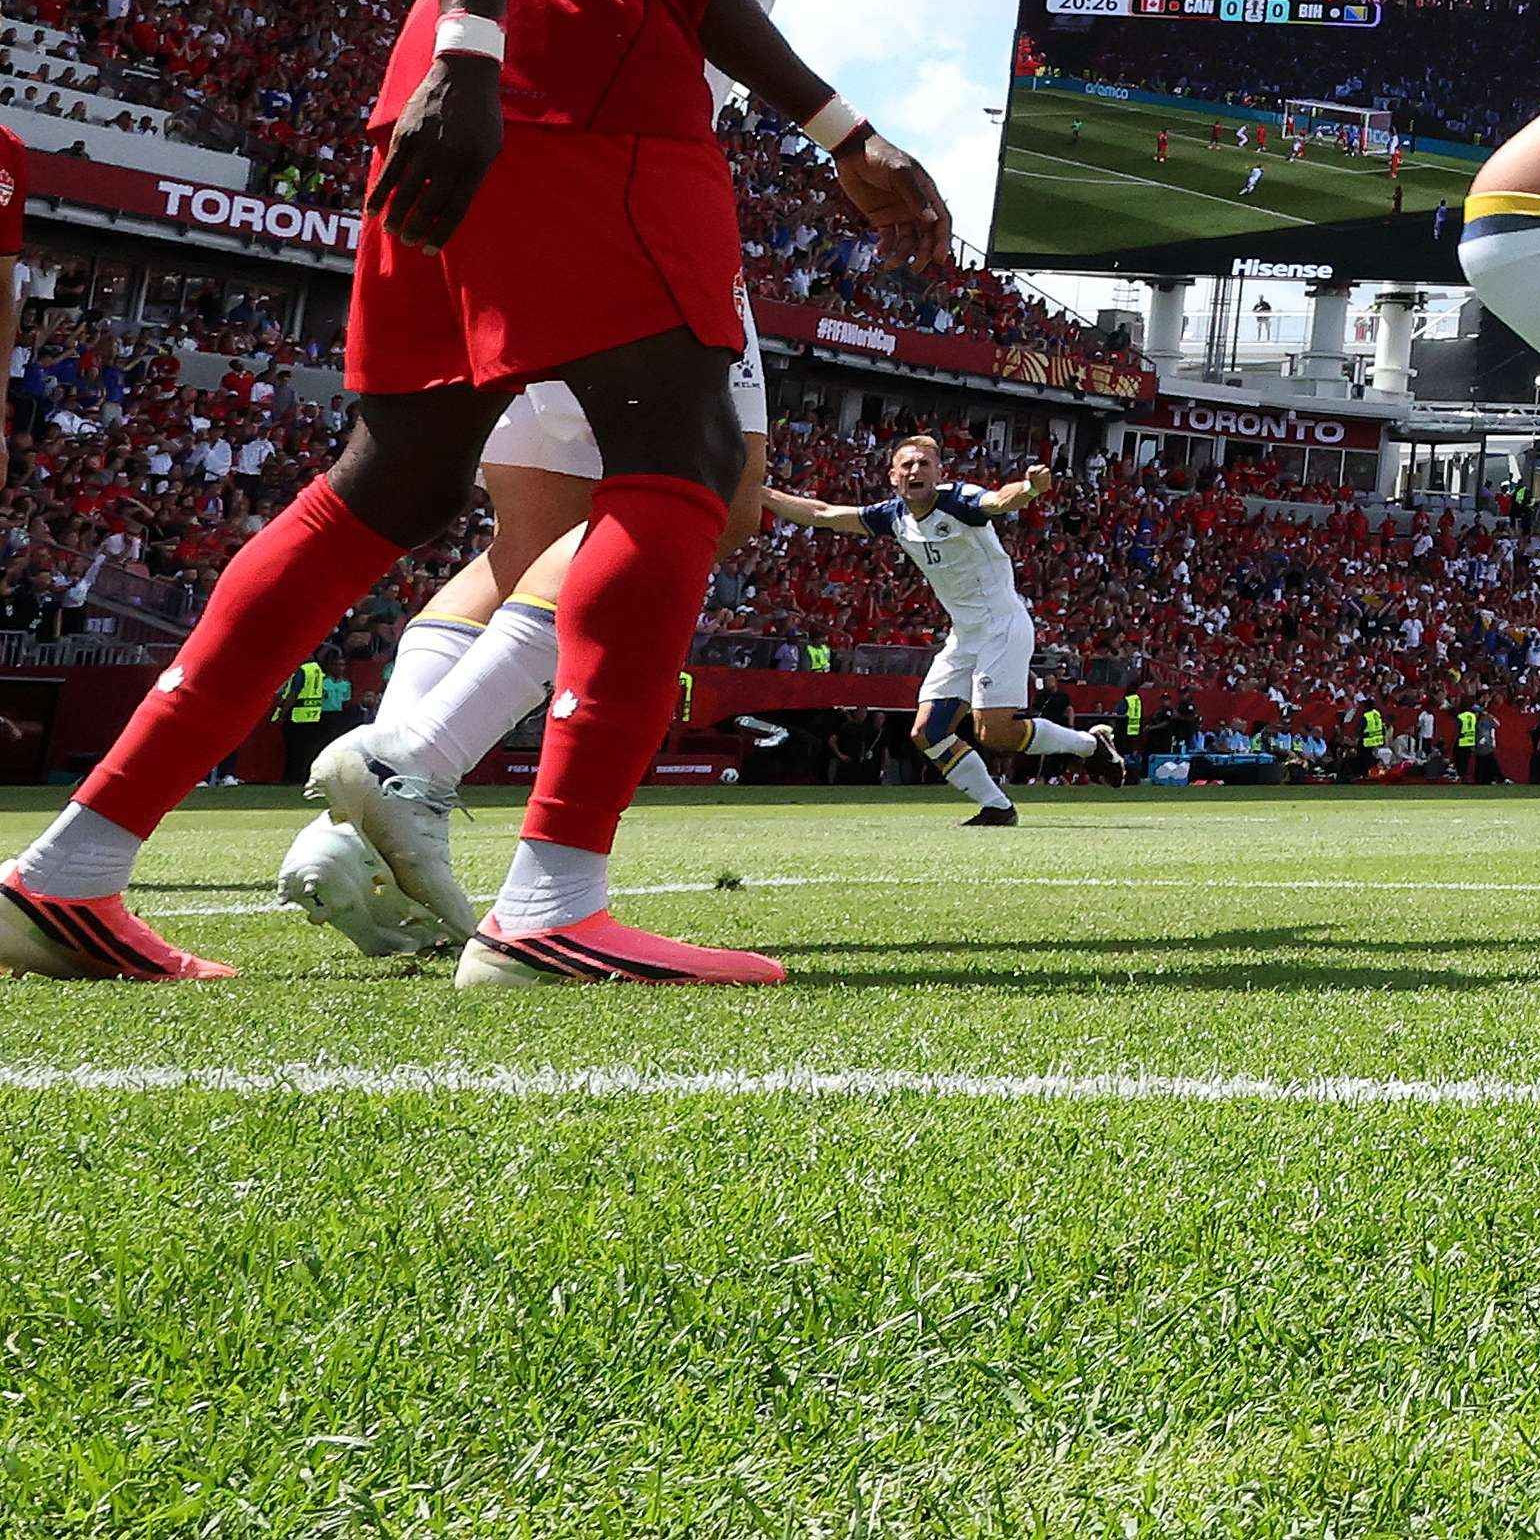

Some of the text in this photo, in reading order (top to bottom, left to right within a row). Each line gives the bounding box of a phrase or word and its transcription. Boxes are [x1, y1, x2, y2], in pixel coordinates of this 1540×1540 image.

[1227, 1, 1238, 15] 0
[1272, 3, 1283, 17] 0
[158, 180, 363, 250] TORONT
[1232, 258, 1334, 279] Hisense
[1168, 403, 1345, 443] TORONTO
[922, 541, 941, 564] 15
